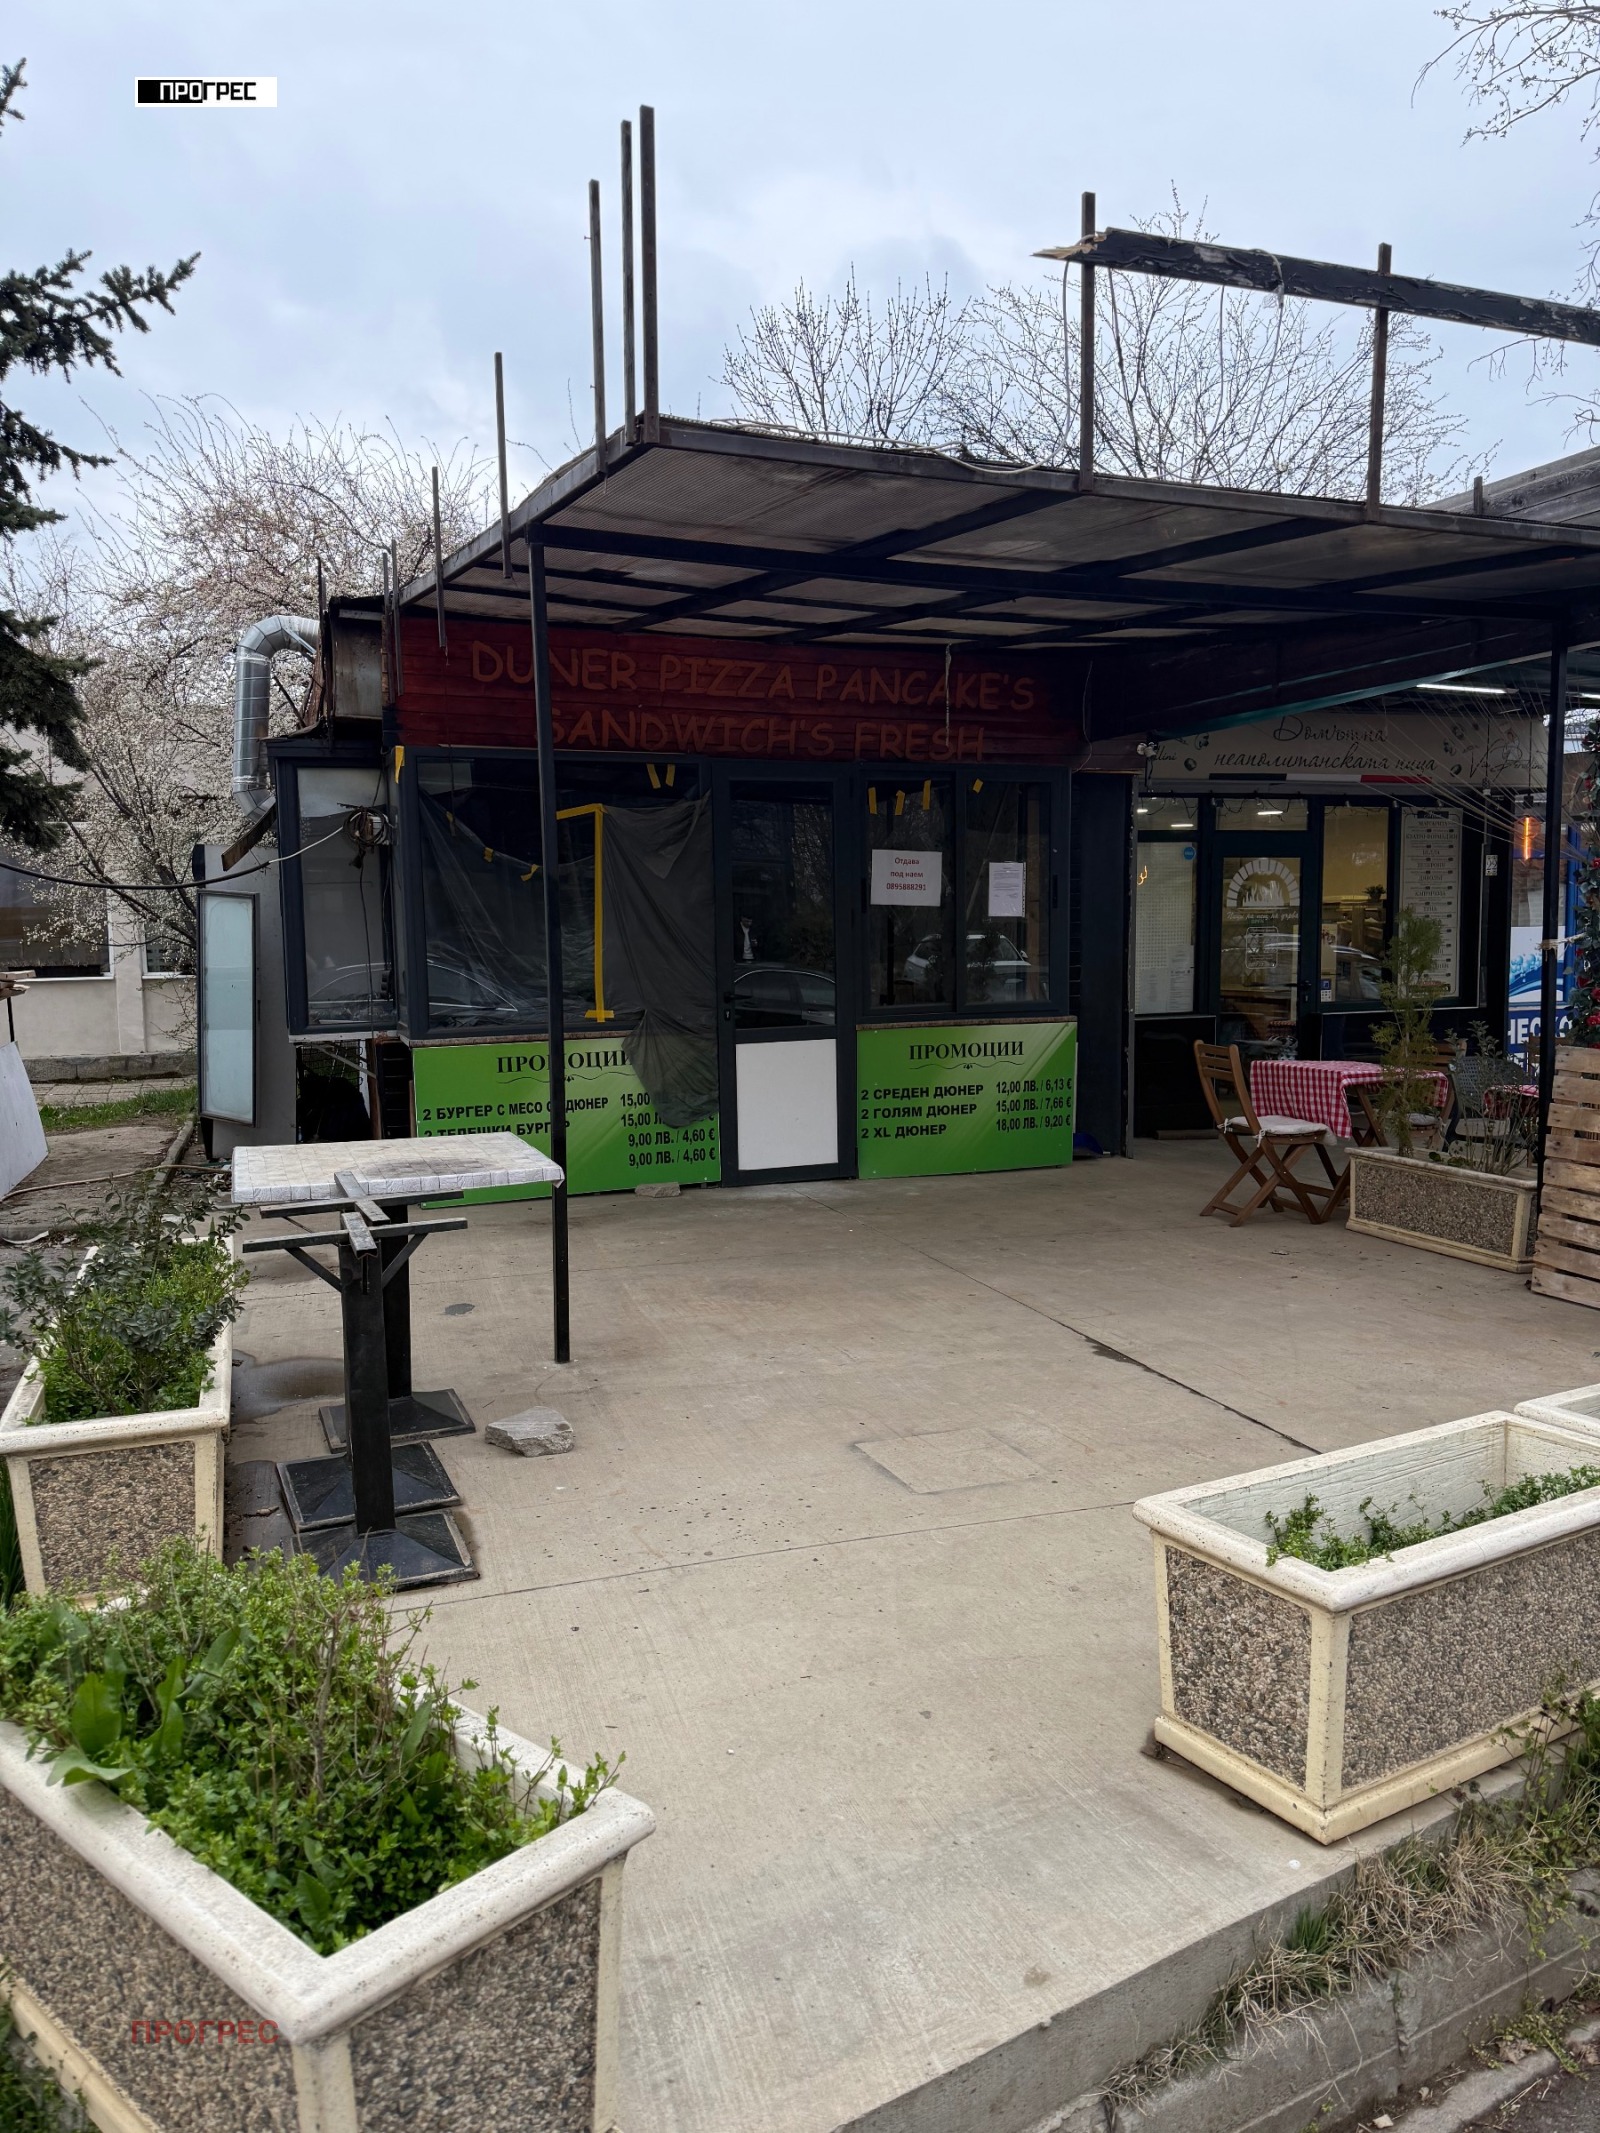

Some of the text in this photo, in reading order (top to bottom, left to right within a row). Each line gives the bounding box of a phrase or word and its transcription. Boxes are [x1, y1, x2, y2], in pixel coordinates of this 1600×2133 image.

[659, 654, 796, 700] PIZZA
[815, 664, 1036, 711] PANCAKE'S
[854, 720, 985, 762] FRESH
[1214, 742, 1438, 776] неаполитанската пица
[894, 857, 920, 866] Отдава
[497, 1050, 632, 1073] ПРООЦИИ
[909, 1041, 1025, 1060] ПРОМОЦИИ
[861, 1090, 869, 1100] 2
[873, 1087, 930, 1100] СРЕДЕН
[933, 1084, 984, 1098] ДЮНЕР
[996, 1080, 1021, 1096] 12,00
[1023, 1080, 1038, 1093] ЛВ.
[1045, 1078, 1065, 1093] 6,13
[1066, 1078, 1072, 1090] €
[423, 1109, 432, 1121] 2
[437, 1105, 493, 1120] БУРГЕР
[497, 1104, 505, 1115] С
[509, 1101, 543, 1115] МЕСО
[565, 1097, 609, 1113] ДЮНЕР
[620, 1092, 650, 1109] 15,00
[861, 1109, 869, 1119] 2
[873, 1106, 923, 1119] ГОЛЯМ
[926, 1103, 978, 1118] ДЮНЕР
[996, 1099, 1021, 1115] 15,00
[1023, 1099, 1038, 1112] ЛВ.
[1045, 1097, 1064, 1112] 7,66
[1066, 1097, 1072, 1109] €
[621, 1112, 651, 1129] 15,00
[861, 1128, 869, 1139] 2
[873, 1127, 891, 1138] XL
[895, 1124, 947, 1139] ДЮНЕР
[996, 1118, 1021, 1134] 18,00
[1022, 1118, 1038, 1130] ЛВ.
[1044, 1115, 1063, 1130] 9,20
[1065, 1114, 1071, 1126] €
[628, 1132, 652, 1148] 9,00
[655, 1131, 674, 1145] ЛВ.
[682, 1128, 706, 1145] 4,60
[708, 1128, 715, 1140] €
[629, 1152, 652, 1169] 9,00
[655, 1151, 675, 1164] ЛВ.
[683, 1148, 706, 1165] 4,60
[709, 1147, 716, 1160] €
